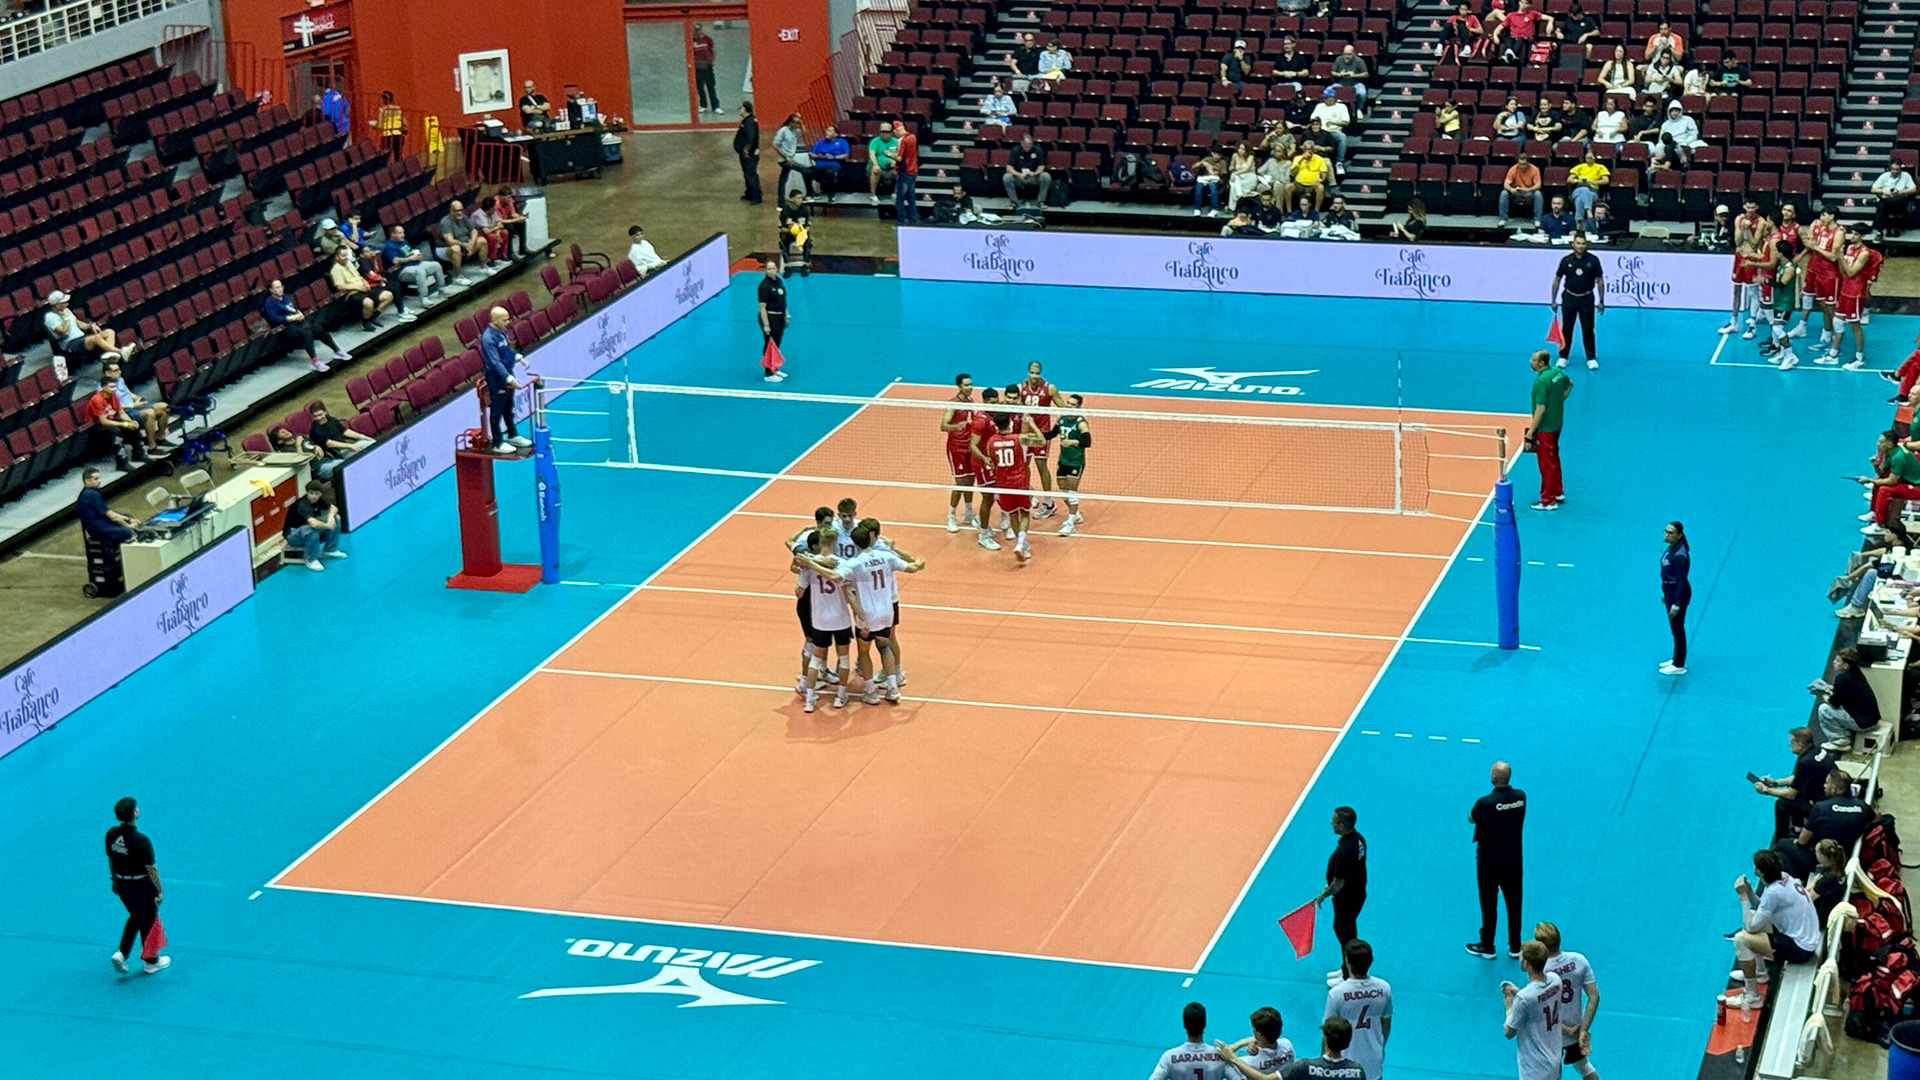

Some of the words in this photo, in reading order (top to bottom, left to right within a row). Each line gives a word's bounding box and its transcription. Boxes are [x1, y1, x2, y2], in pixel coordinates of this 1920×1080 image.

[781, 29, 800, 41] EXIT
[1605, 274, 1671, 302] rabanco
[1130, 379, 1306, 396] MIZUNO
[995, 448, 1015, 467] 10
[838, 543, 855, 558] 10
[871, 570, 886, 590] 11
[1496, 800, 1524, 811] Canada
[1832, 804, 1863, 813] Canada
[565, 938, 823, 978] MIZUNO
[1343, 988, 1384, 1001] BUDACH
[1355, 1004, 1371, 1029] 4
[1542, 1000, 1560, 1031] 14
[1308, 1065, 1361, 1078] DROPPERT
